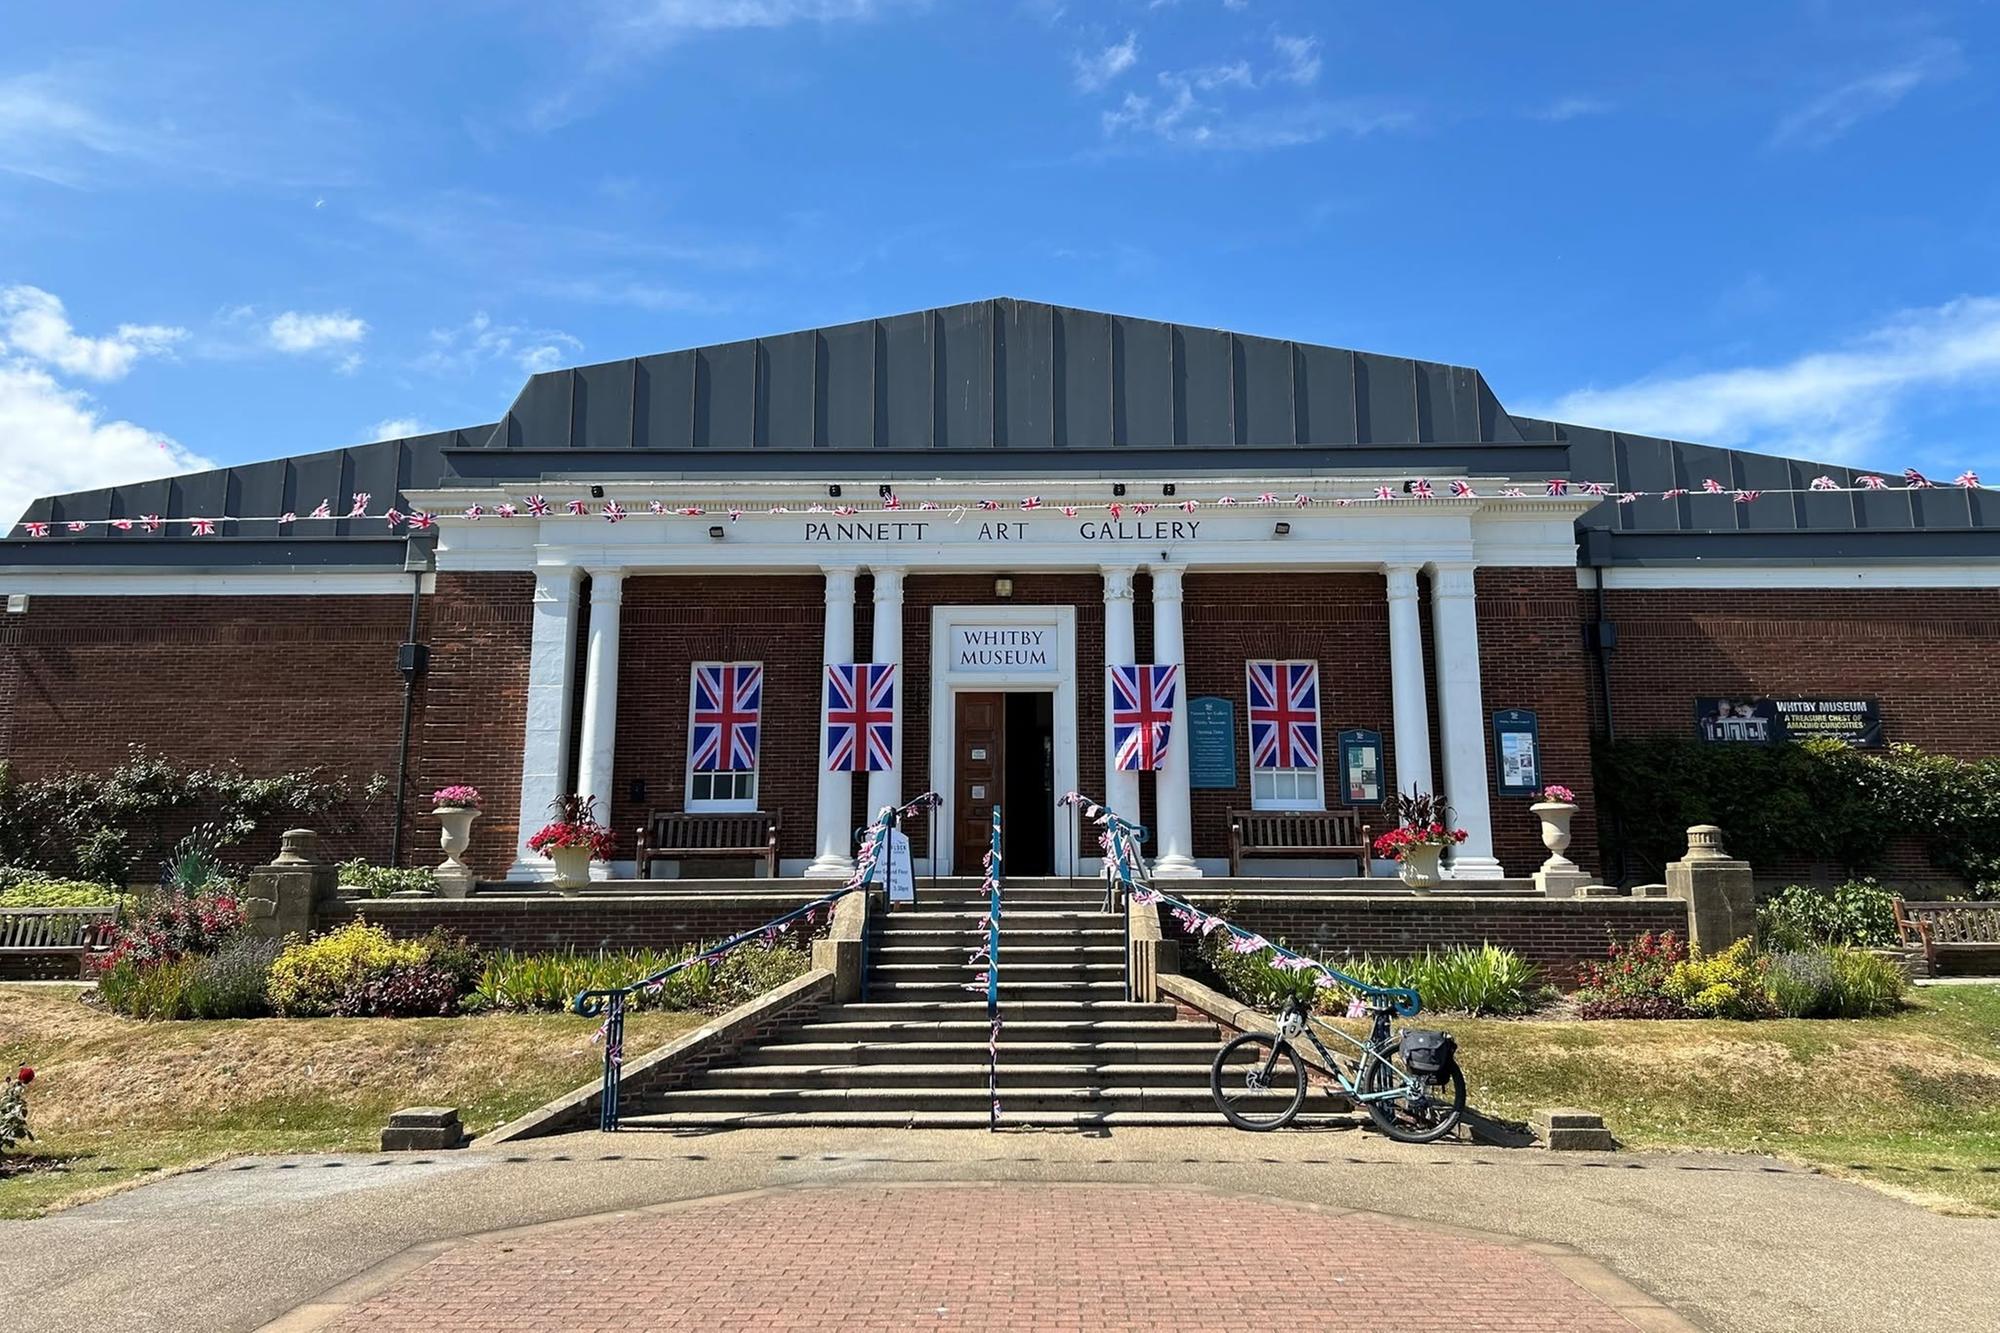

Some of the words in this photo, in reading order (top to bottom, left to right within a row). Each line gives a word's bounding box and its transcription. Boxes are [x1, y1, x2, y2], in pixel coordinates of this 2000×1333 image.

[805, 522, 929, 541] PANNETT
[978, 522, 1030, 540] ART
[1079, 521, 1201, 540] GALLERY
[963, 630, 1044, 646] WHITBY
[960, 649, 1047, 665] MUSEUM
[1776, 701, 1816, 712] WHITBY
[1819, 701, 1868, 712] MUSEUM
[1784, 714, 1790, 722] A
[1791, 714, 1827, 722] TREASURE
[1828, 714, 1851, 722] CHEST
[1852, 714, 1862, 722] OF
[1786, 721, 1819, 729] AMAZING
[1820, 721, 1864, 729] CURIOSITIES
